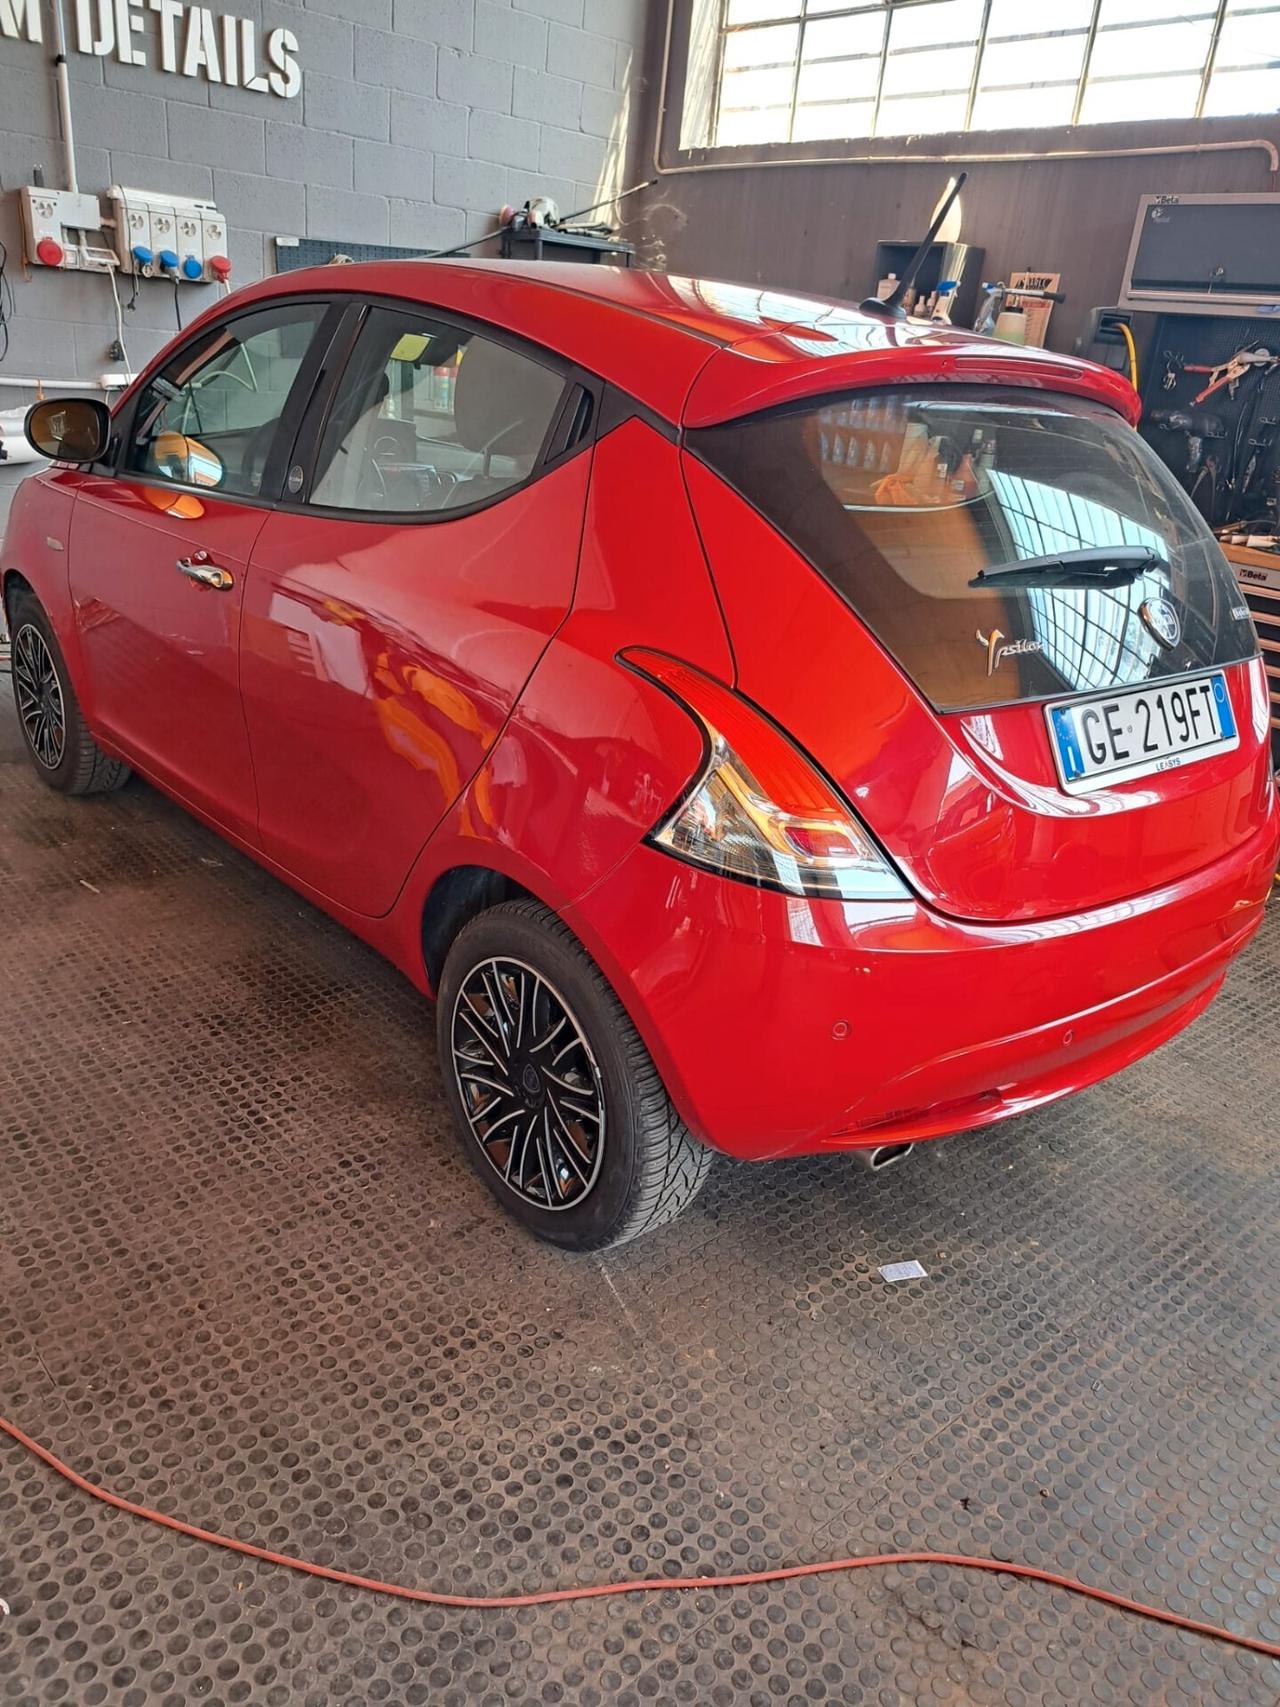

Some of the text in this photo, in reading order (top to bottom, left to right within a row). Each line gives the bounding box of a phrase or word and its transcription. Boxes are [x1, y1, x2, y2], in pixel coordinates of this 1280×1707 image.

[74, 0, 301, 98] DETAILS
[1246, 570, 1267, 581] Beta
[1081, 704, 1130, 765] GE
[1135, 685, 1218, 753] 219FT
